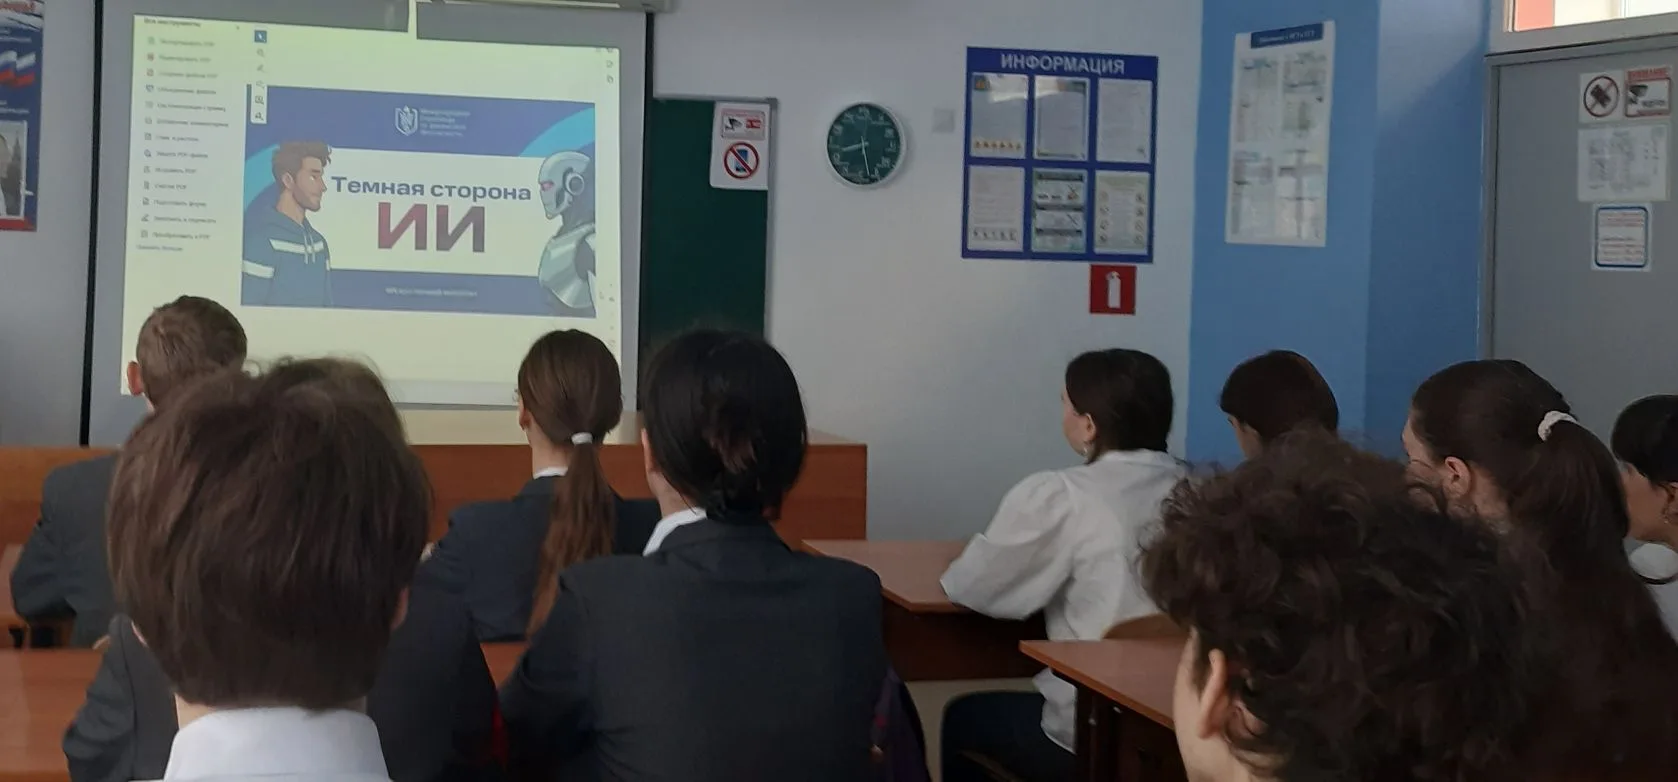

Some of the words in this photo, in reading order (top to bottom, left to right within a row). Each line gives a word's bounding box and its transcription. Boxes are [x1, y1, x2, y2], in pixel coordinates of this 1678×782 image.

[1001, 53, 1125, 75] ИНФОРМАЦИЯ
[331, 176, 425, 197] Темная
[430, 183, 532, 203] сторона
[377, 201, 485, 253] ИИ
